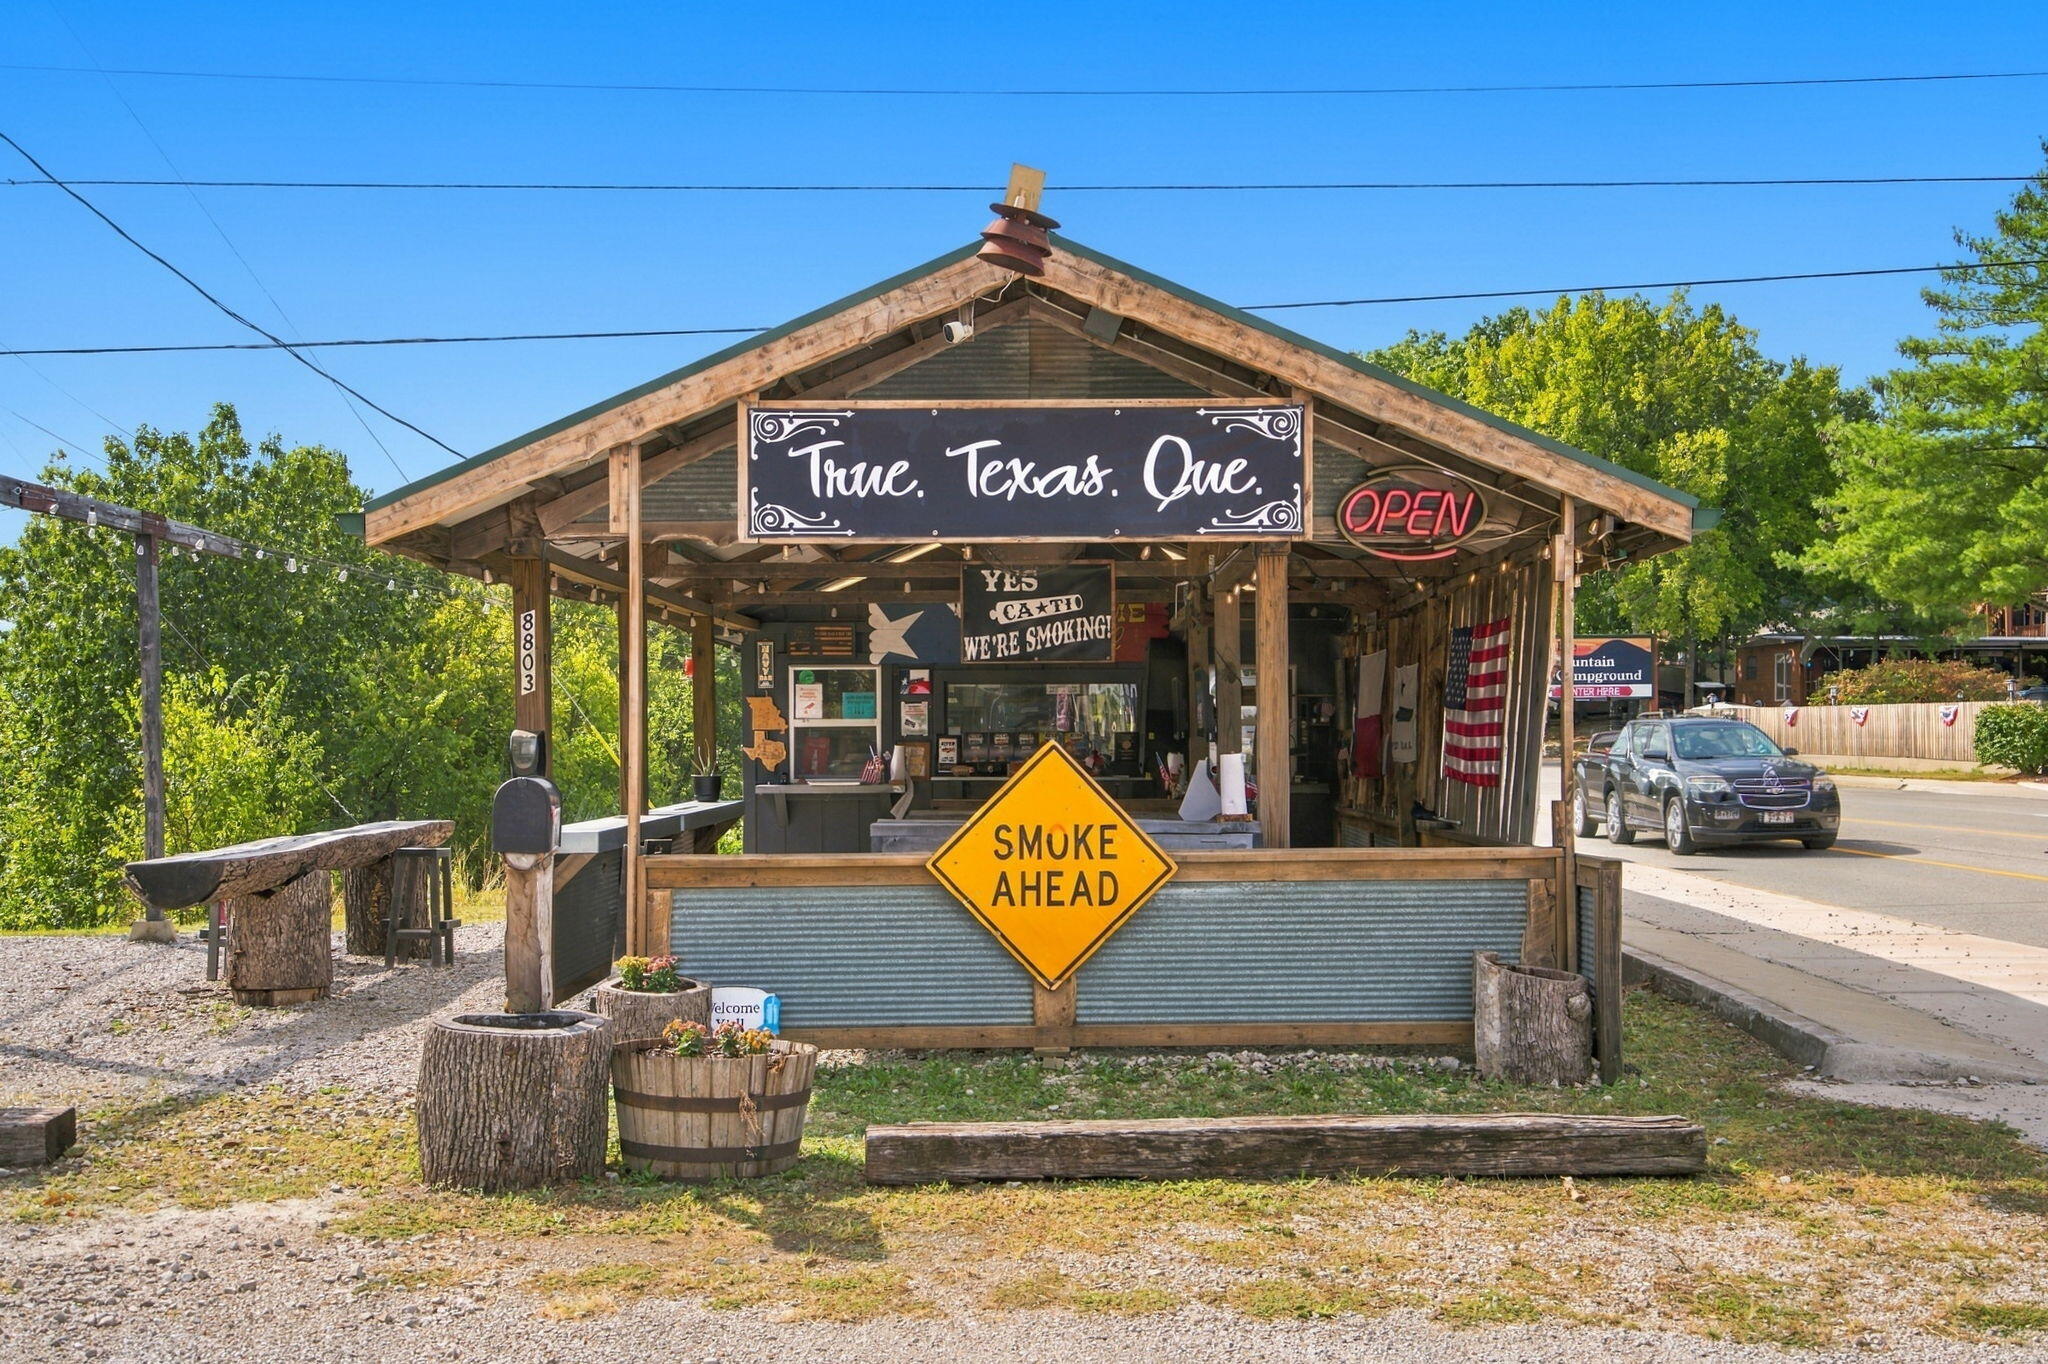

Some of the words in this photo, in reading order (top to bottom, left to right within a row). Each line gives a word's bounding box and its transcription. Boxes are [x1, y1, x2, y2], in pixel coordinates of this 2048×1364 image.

[788, 440, 924, 499] True.
[945, 440, 1118, 501] Texas.
[1142, 434, 1263, 513] Que.
[1345, 489, 1475, 536] OPEN
[981, 570, 1038, 591] YES
[522, 613, 534, 691] 8803
[964, 631, 1020, 660] WE'RE
[1026, 615, 1111, 652] SMOKING!
[1556, 669, 1642, 684] Cmpground
[1573, 655, 1615, 667] untain
[1573, 687, 1595, 697] NTER
[1596, 687, 1620, 697] HERE
[993, 824, 1119, 861] SMOKE
[991, 870, 1119, 907] AHEAD
[712, 1002, 760, 1014] elcome
